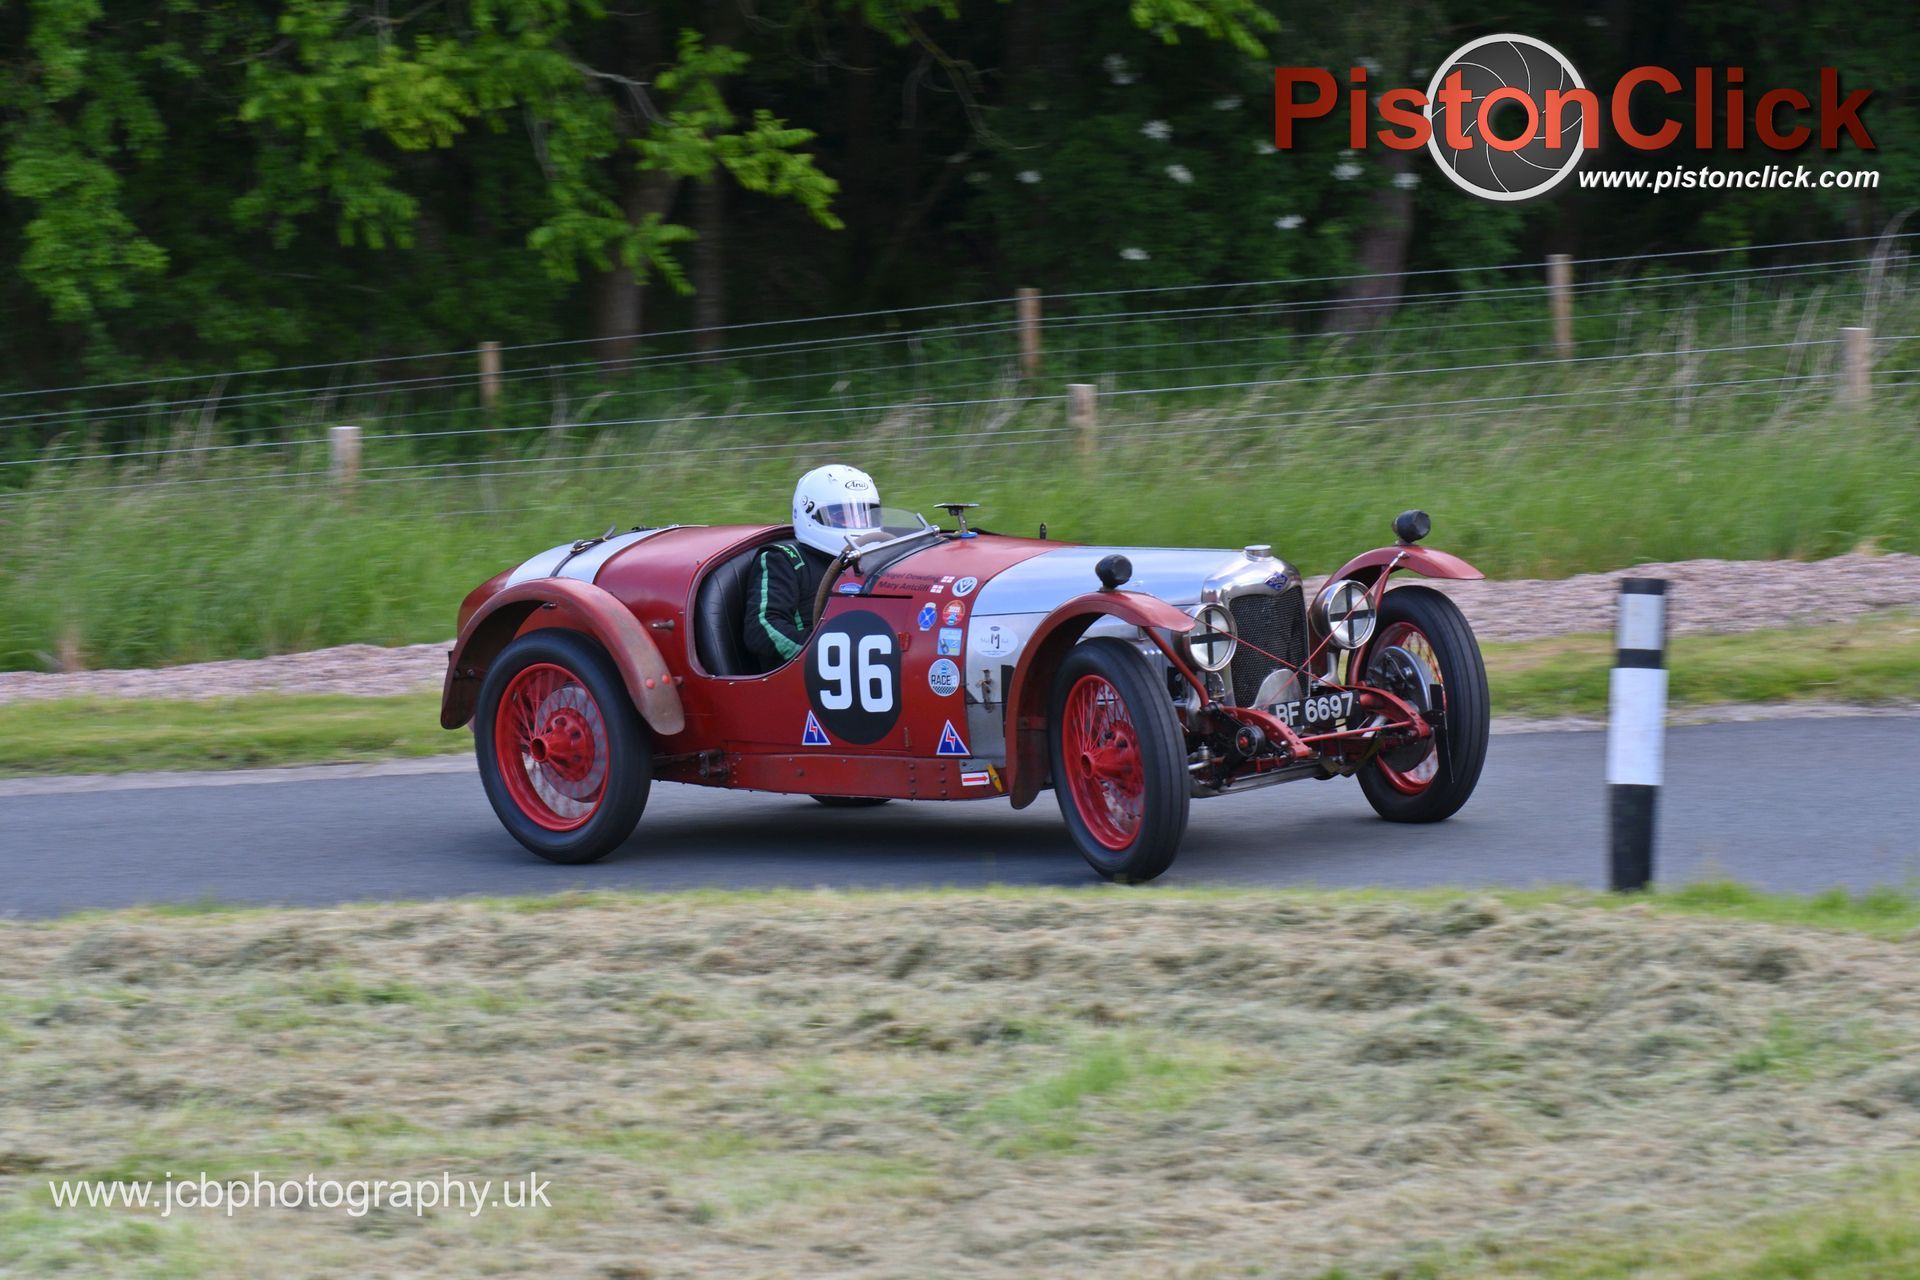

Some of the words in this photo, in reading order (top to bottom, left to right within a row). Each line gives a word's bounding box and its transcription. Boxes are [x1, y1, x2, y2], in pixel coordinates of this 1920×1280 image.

[879, 581, 899, 590] Mary
[818, 632, 893, 712] 96
[1275, 701, 1300, 726] BF
[1305, 692, 1353, 723] 6697
